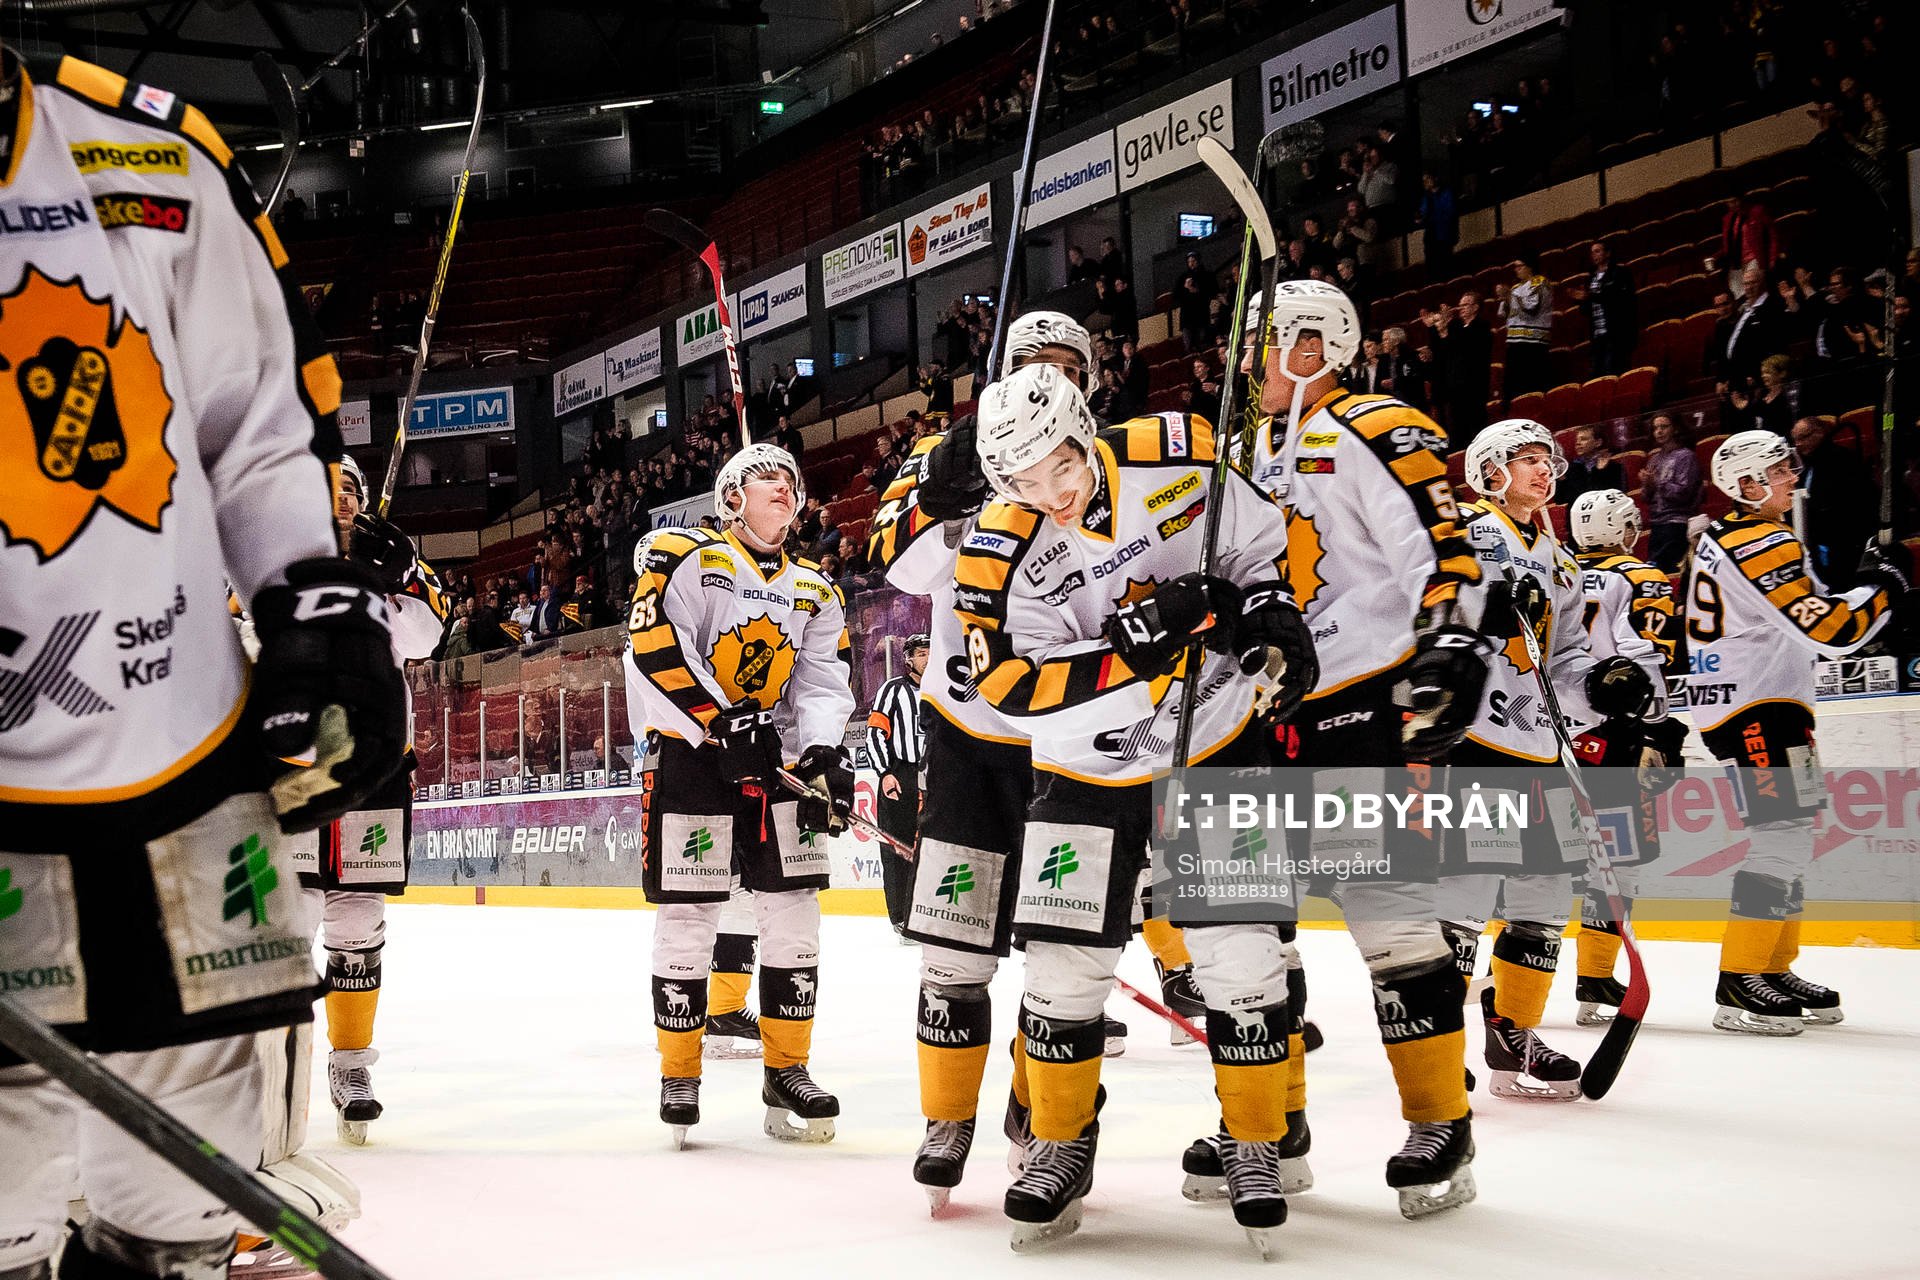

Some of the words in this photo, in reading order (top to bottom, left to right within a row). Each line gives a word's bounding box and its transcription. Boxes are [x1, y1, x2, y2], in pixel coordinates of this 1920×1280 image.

[1268, 42, 1390, 116] Bilmetro
[1124, 104, 1224, 178] gavle.se
[72, 145, 181, 169] engcon
[1030, 158, 1112, 203] ndelsbanken
[0, 199, 90, 233] LIDEN
[96, 197, 184, 231] skebo
[825, 236, 882, 276] PRENOVA
[771, 284, 804, 309] SKANSKA
[1295, 314, 1325, 322] CCM
[625, 349, 660, 371] Maskiner
[337, 415, 366, 427] kPart
[412, 397, 504, 423] TPM
[407, 423, 491, 437] NDUSTRIMÅLNING
[495, 421, 510, 429] AB
[989, 418, 1016, 436] CCM
[1147, 474, 1199, 509] engcon
[1085, 506, 1111, 530] SHL
[970, 535, 1005, 549] SPORT
[1038, 540, 1068, 567] LEAB
[759, 561, 780, 571] SHL
[1092, 535, 1151, 580] BOLIDEN
[743, 589, 790, 608] BOLIDEN
[1642, 610, 1667, 636] 17
[1789, 596, 1832, 629] 29
[1317, 711, 1374, 731] CCM
[1742, 722, 1779, 799] REPAY
[427, 829, 441, 859] EN
[443, 829, 462, 858] BRA
[464, 828, 499, 858] START
[511, 825, 587, 854] BAUER
[342, 859, 402, 869] martinsons
[666, 864, 729, 877] martinsons
[1021, 894, 1100, 913] martinsons
[915, 903, 990, 930] martinsons
[927, 967, 954, 978] CCM
[1026, 992, 1052, 1006] CCM
[1230, 993, 1265, 1006] CCM
[1219, 1041, 1289, 1061] NORRAN
